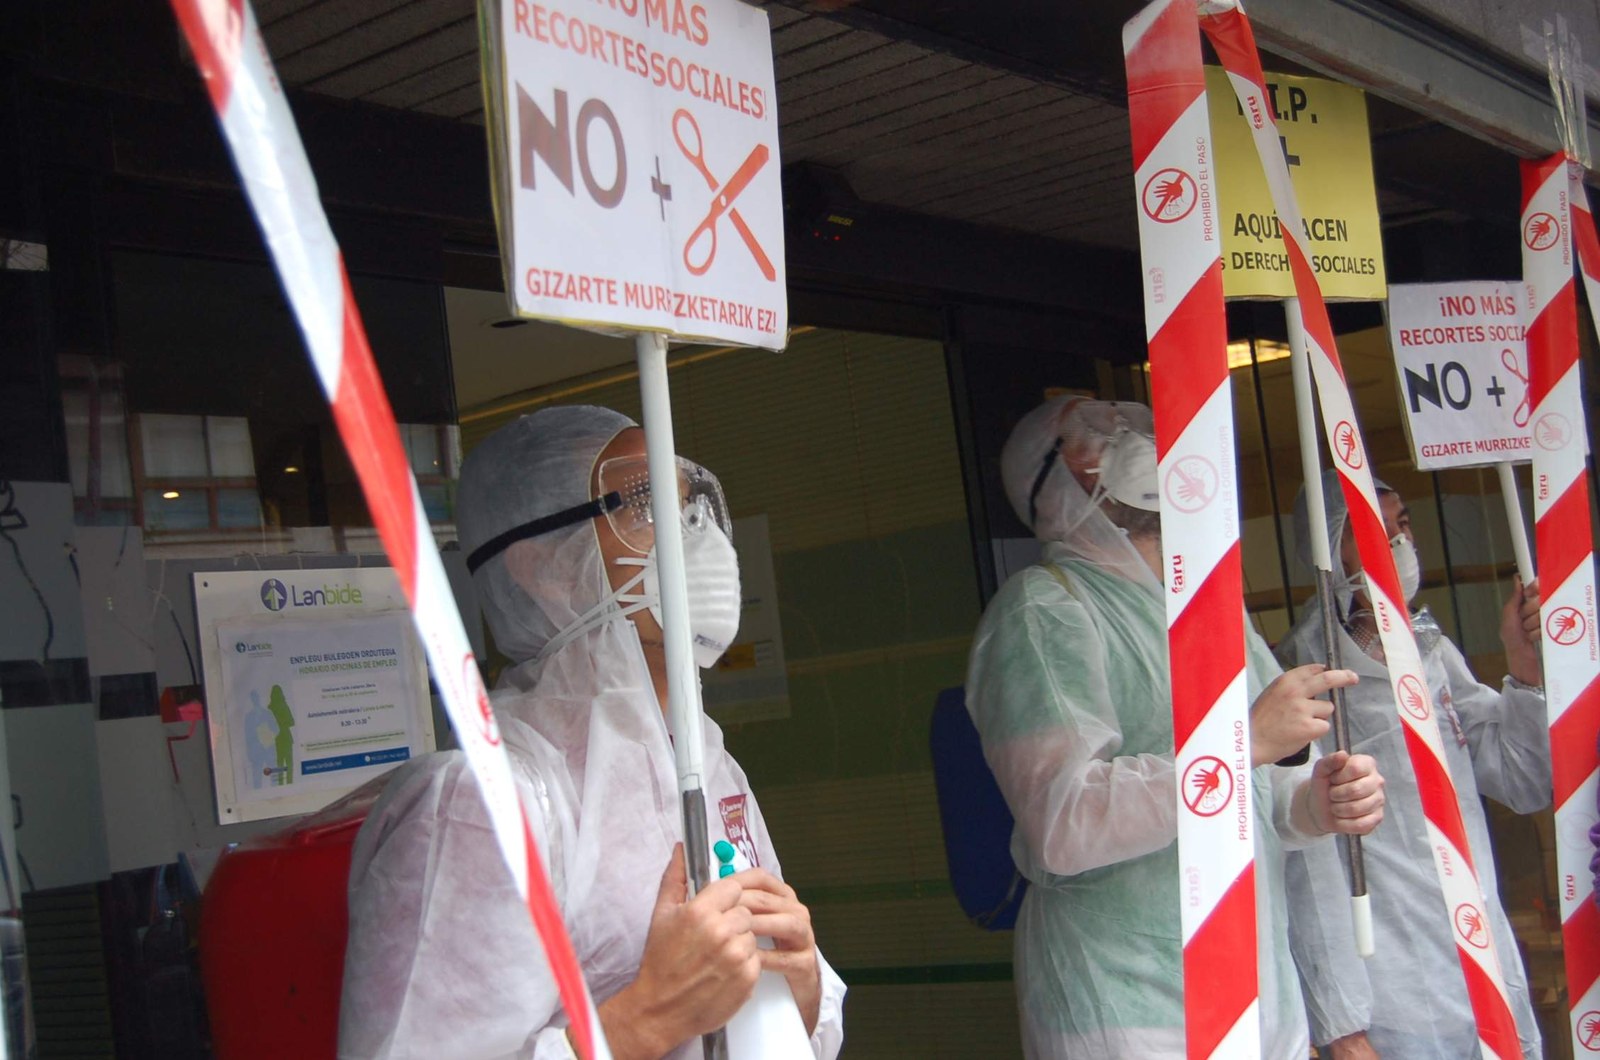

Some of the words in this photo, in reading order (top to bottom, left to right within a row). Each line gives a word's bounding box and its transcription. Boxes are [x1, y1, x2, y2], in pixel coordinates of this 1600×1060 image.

[512, 0, 649, 78] RECORTES
[514, 79, 627, 209] NO
[1199, 169, 1209, 183] EL
[1199, 185, 1213, 241] PROHIBIDO
[1559, 191, 1567, 211] PASO
[1301, 217, 1348, 242] ACEN
[1561, 214, 1568, 224] EL
[1561, 224, 1570, 265] PROHIBIDO
[1231, 252, 1290, 272] DERECH
[1311, 255, 1376, 275] SOCIALES
[526, 267, 618, 305] GIZARTE
[757, 308, 777, 334] EZ!
[1439, 296, 1476, 317] ¡NO
[1480, 289, 1516, 316] MÁS
[1400, 326, 1485, 346] RECORTES
[1488, 325, 1527, 342] SOCIA
[1404, 361, 1472, 413] NO
[1421, 441, 1472, 458] GIZARTE
[1475, 436, 1532, 452] MURRIZKE
[1538, 473, 1548, 501] faru
[1172, 554, 1184, 594] faru
[291, 584, 363, 607] Lanbide
[1587, 607, 1594, 617] EL
[1588, 618, 1597, 661] PROHIBIDO
[1233, 720, 1244, 753] PASO
[1236, 755, 1245, 771] EL
[1236, 773, 1248, 840] PROHIBIDO
